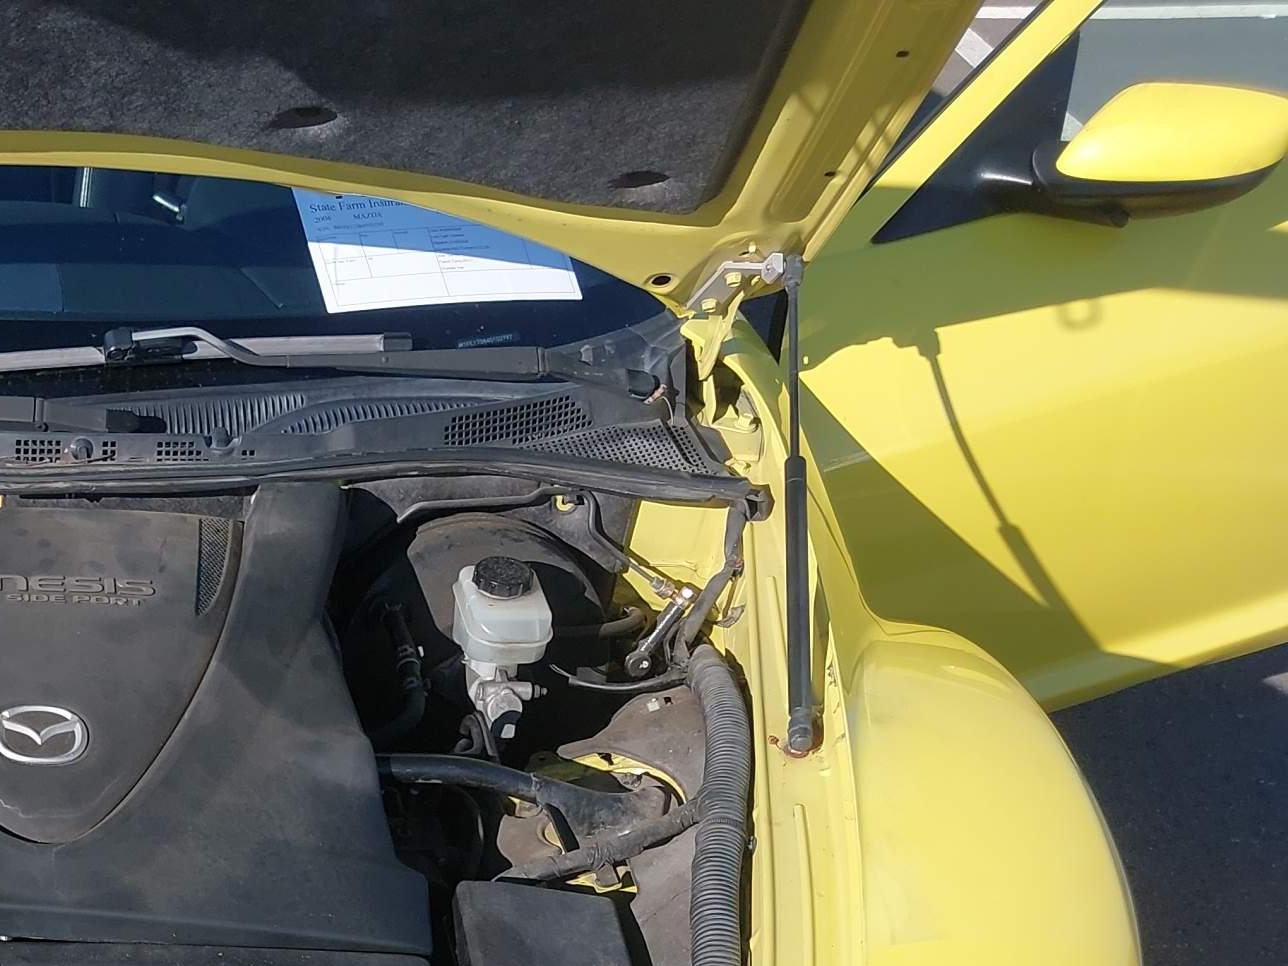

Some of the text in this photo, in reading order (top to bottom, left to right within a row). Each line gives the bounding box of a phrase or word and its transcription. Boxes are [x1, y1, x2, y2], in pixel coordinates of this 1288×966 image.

[309, 203, 336, 213] State
[338, 201, 366, 211] Farm
[6, 593, 66, 604] SIDE
[73, 595, 142, 607] PORT
